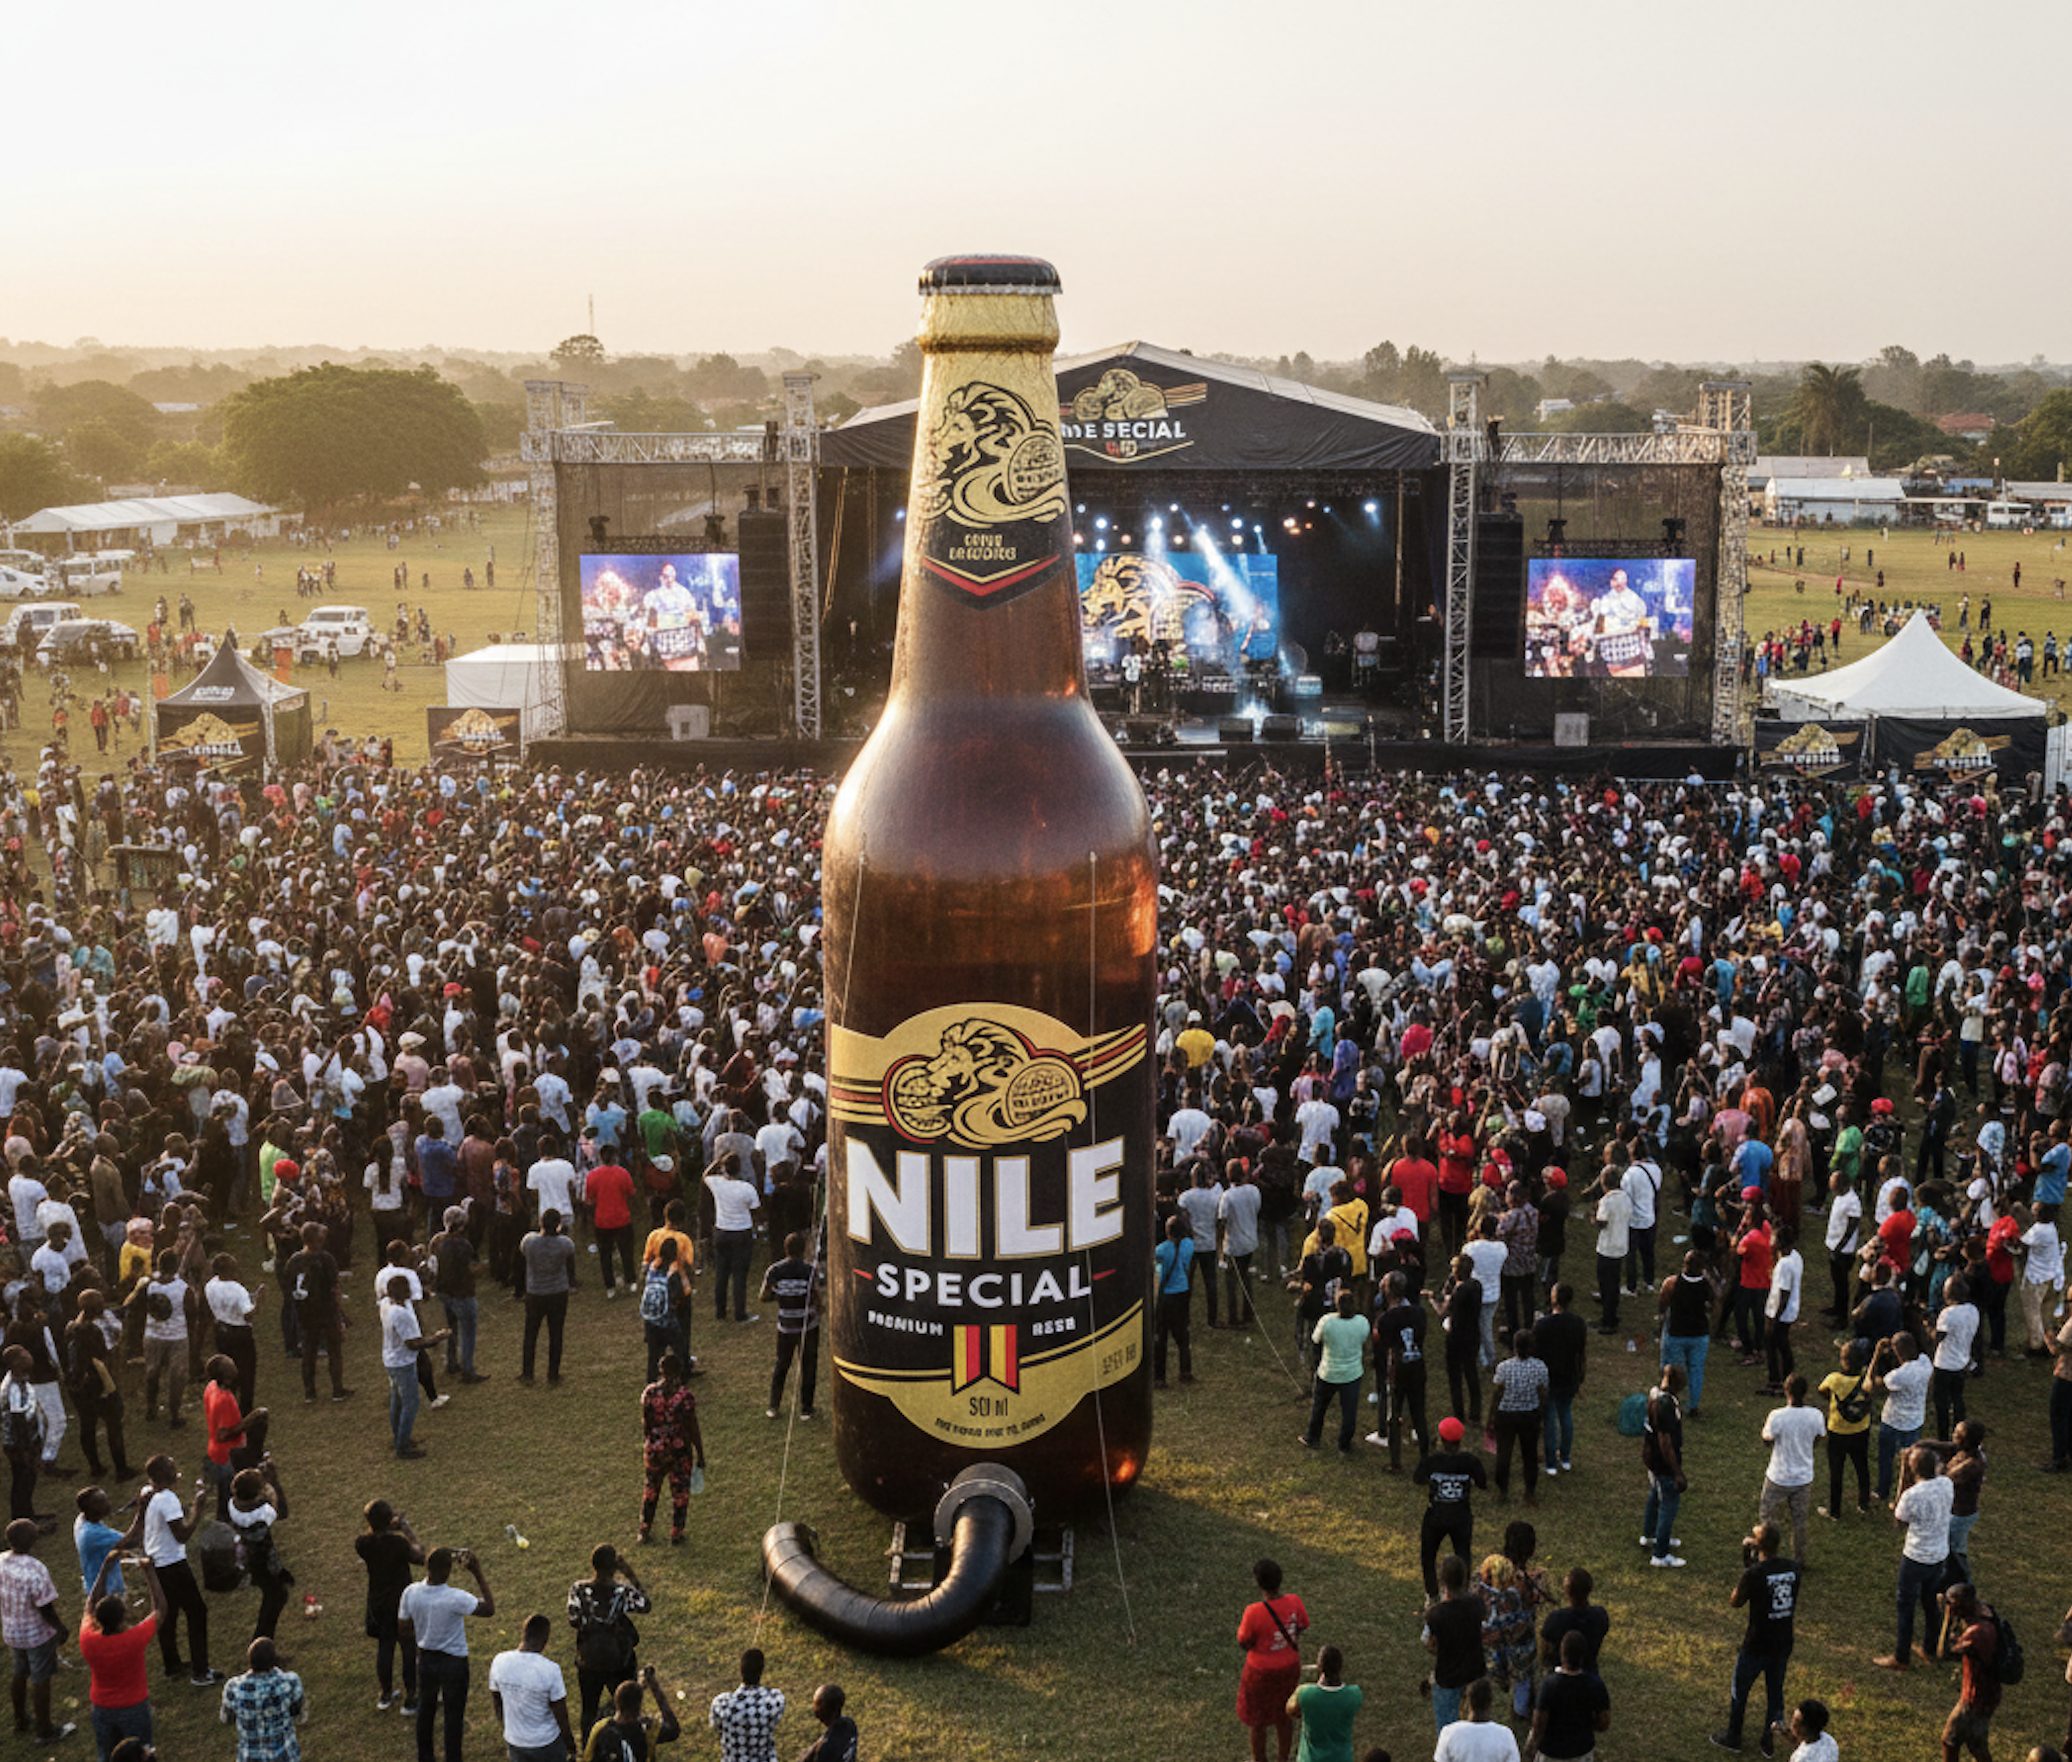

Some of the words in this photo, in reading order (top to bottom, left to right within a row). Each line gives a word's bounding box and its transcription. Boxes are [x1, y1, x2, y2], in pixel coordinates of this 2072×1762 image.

[1103, 421, 1187, 439] SECIAL
[846, 1135, 1125, 1260] NILE
[876, 1262, 1092, 1308] SPECIAL
